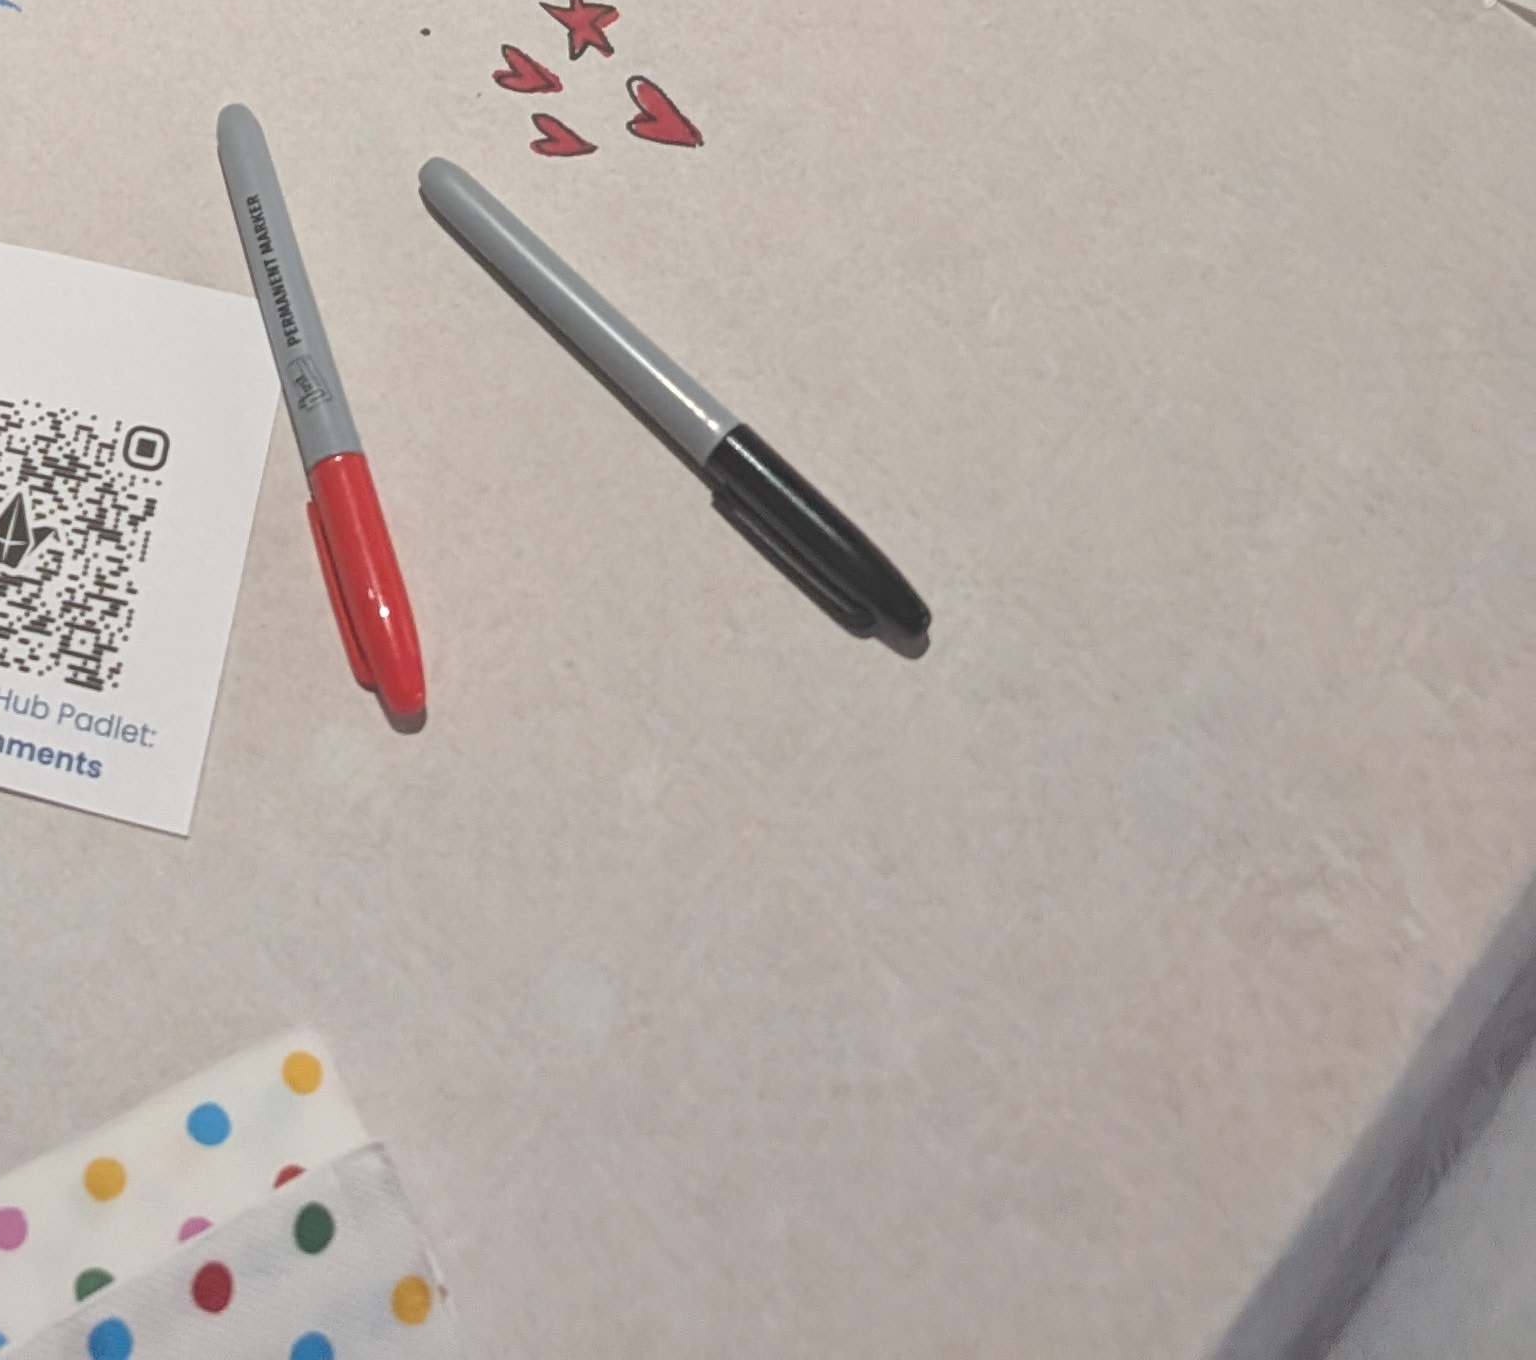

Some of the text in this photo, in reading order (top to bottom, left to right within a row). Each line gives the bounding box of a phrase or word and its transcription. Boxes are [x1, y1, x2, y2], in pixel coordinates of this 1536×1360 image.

[246, 194, 301, 348] PERMANENT MARKER
[58, 702, 157, 748] Padlet:
